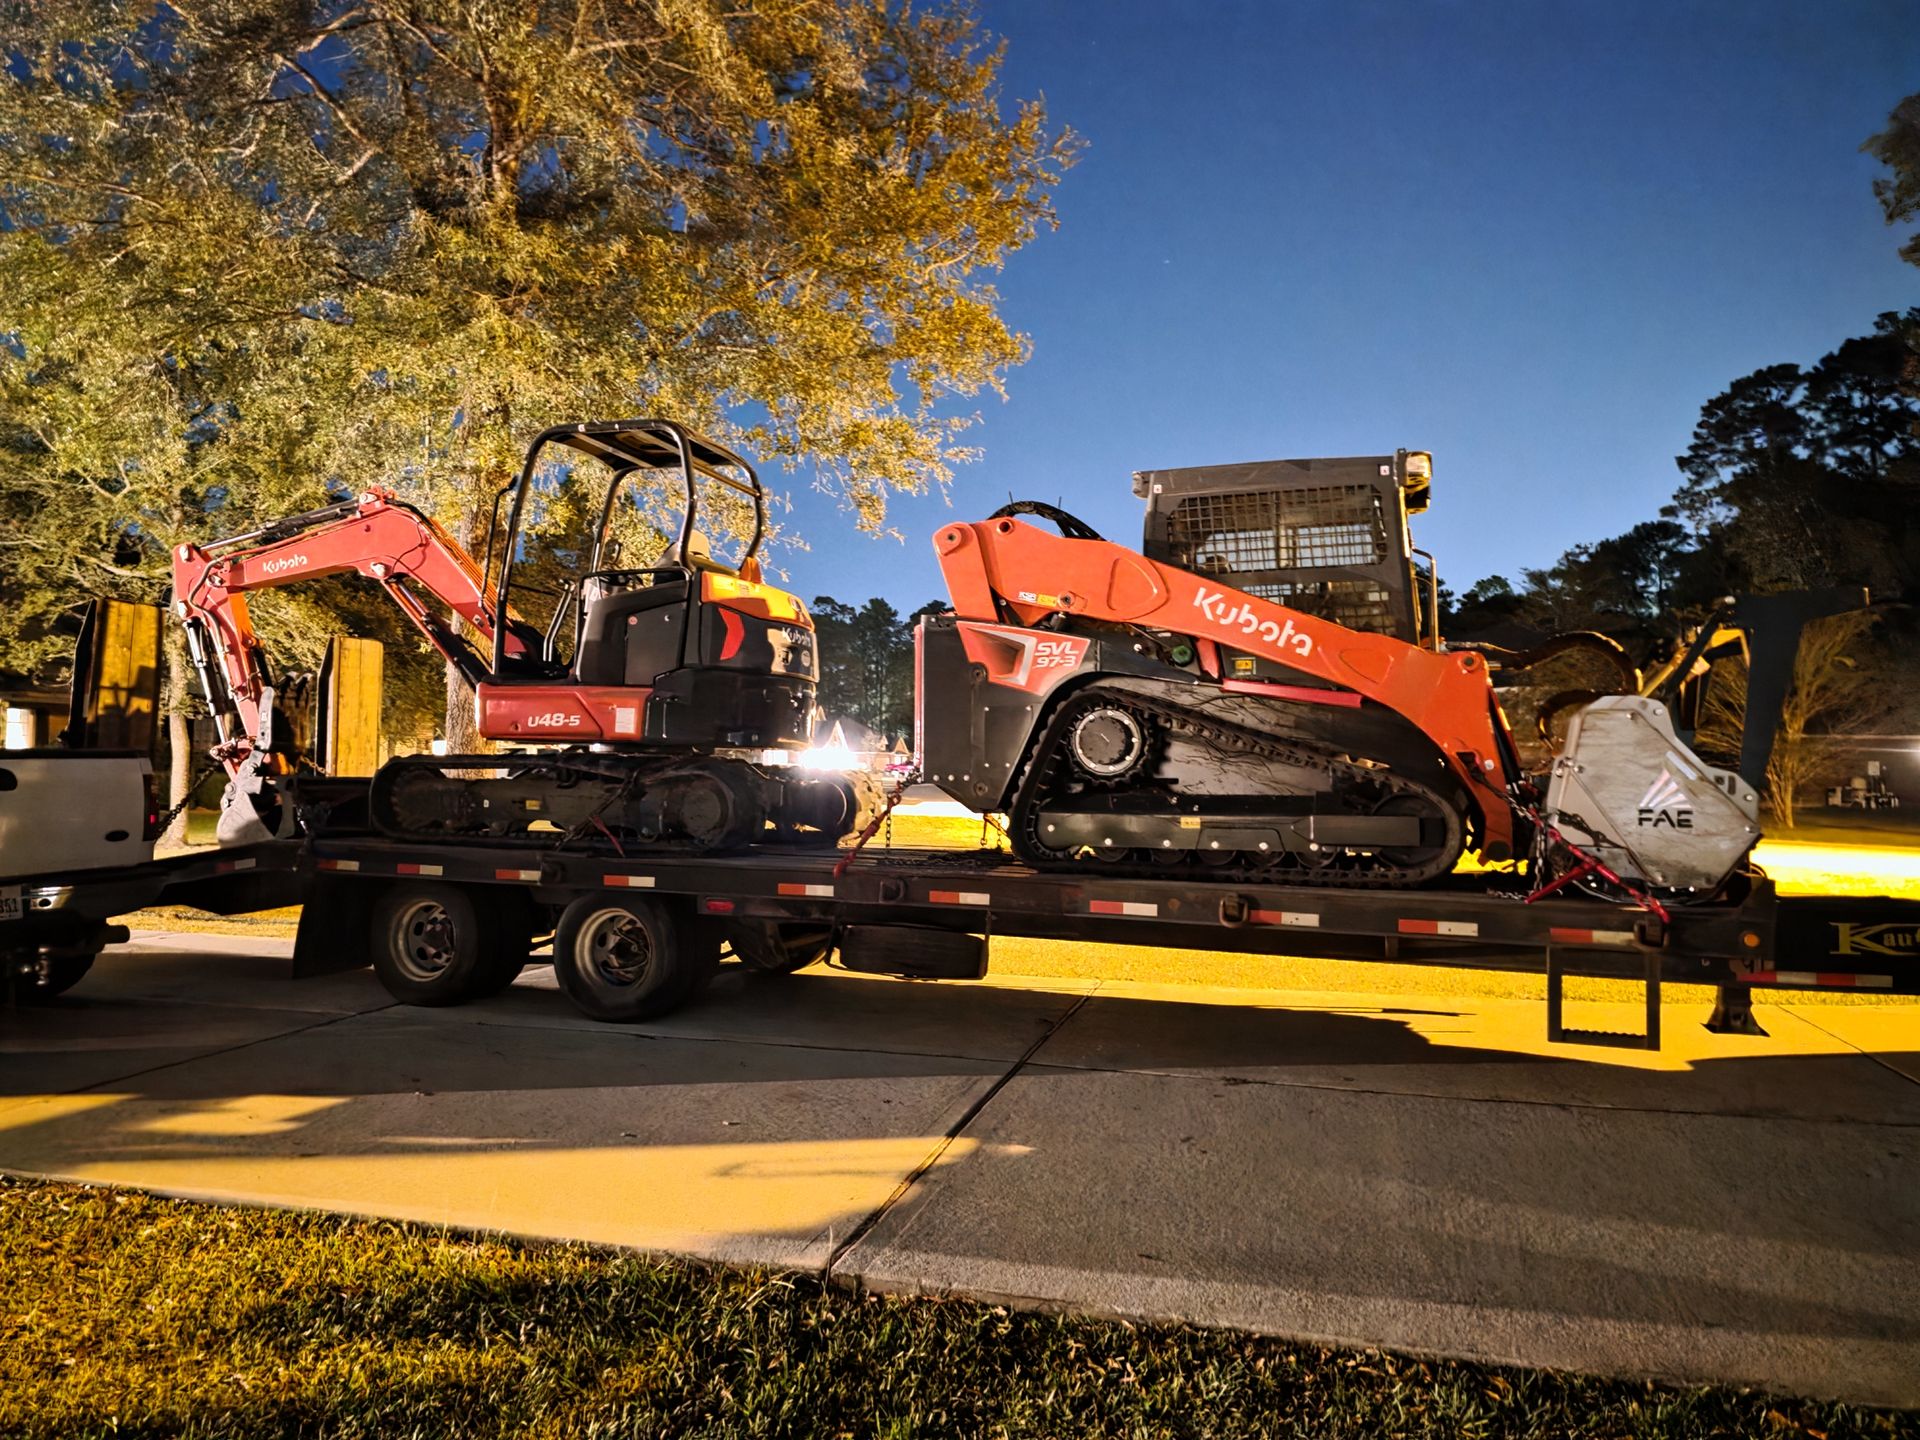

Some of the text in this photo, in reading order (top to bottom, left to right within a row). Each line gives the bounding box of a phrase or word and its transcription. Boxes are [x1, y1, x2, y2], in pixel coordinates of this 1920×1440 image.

[263, 554, 308, 574] Kubota
[1193, 587, 1313, 657] Kubota
[1035, 641, 1079, 656] SVL
[1035, 656, 1076, 668] 97-3
[527, 713, 580, 727] U48-5
[1638, 809, 1693, 828] FAE
